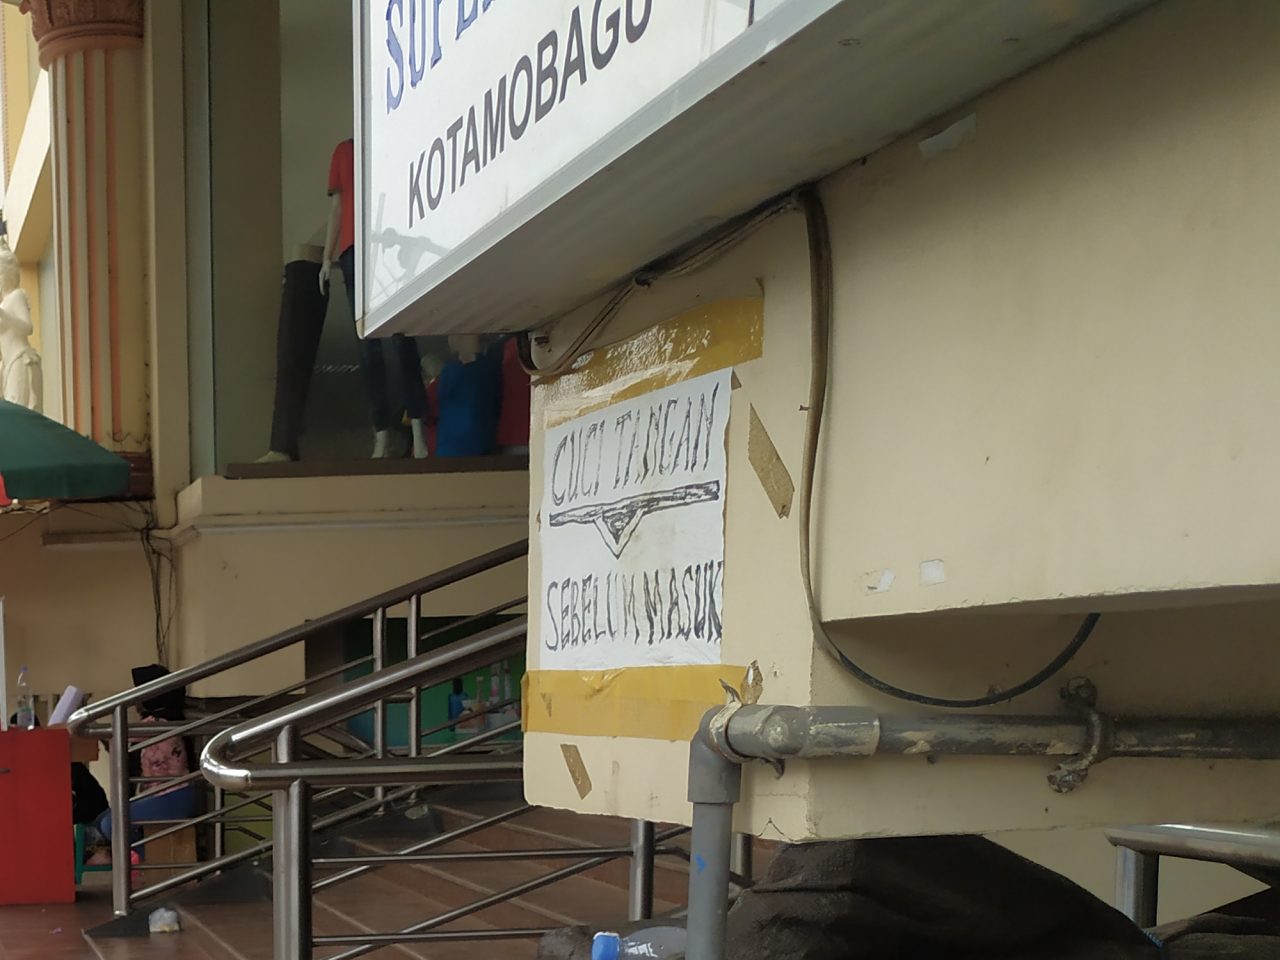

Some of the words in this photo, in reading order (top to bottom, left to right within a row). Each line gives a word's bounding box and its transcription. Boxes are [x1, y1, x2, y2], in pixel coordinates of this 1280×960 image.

[408, 0, 652, 229] KOTAMOBAGU
[552, 419, 605, 505] CUCI
[613, 382, 719, 489] TANGAN
[546, 573, 640, 651] SEBELUM
[643, 560, 723, 646] MASUK
